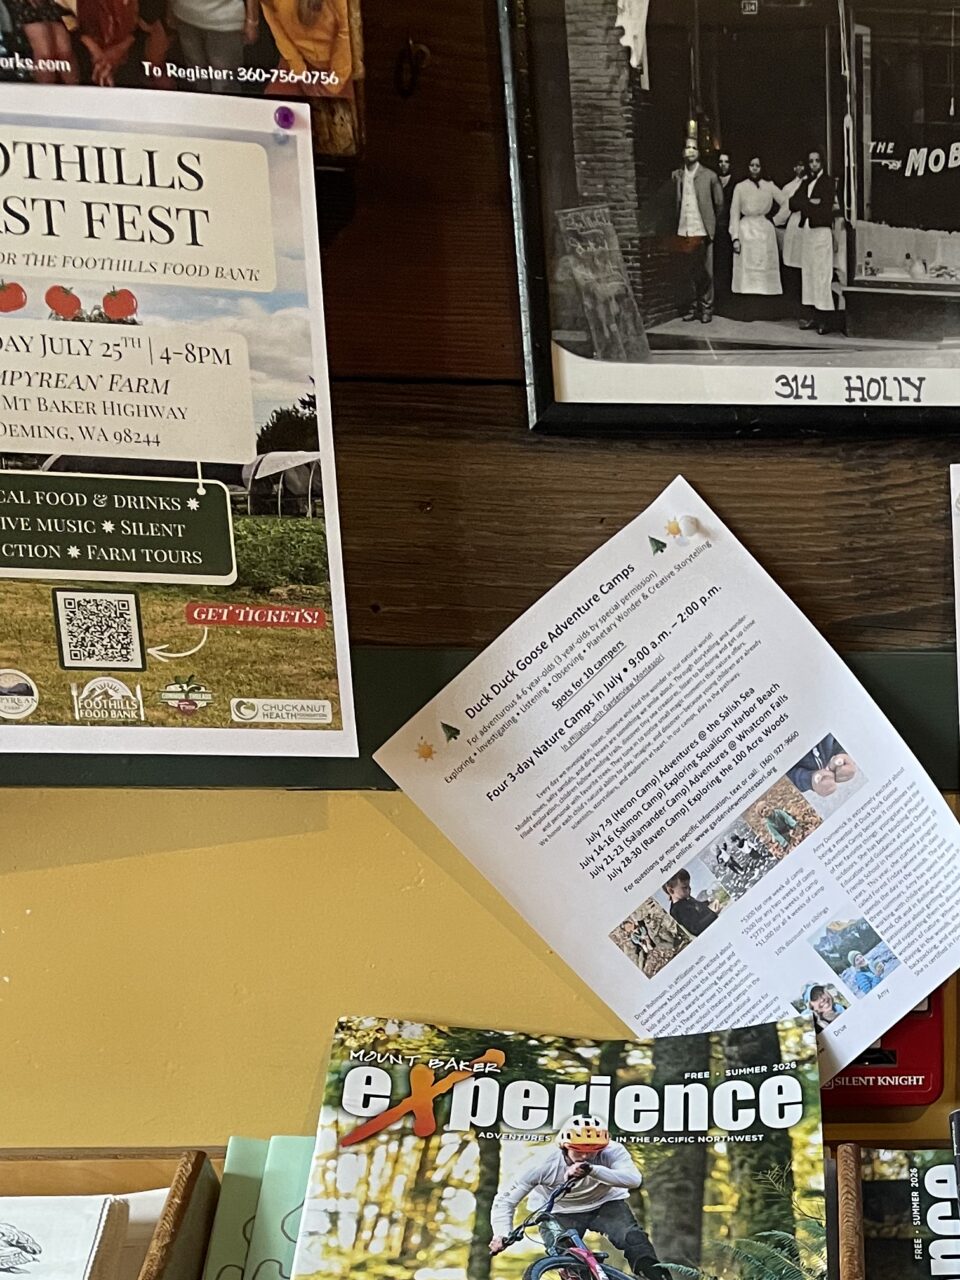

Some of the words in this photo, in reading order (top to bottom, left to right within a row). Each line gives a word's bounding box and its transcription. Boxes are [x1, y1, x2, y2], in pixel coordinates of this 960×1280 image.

[142, 61, 162, 77] To
[166, 63, 234, 82] Register:
[237, 67, 339, 85] 360-756-0756
[868, 141, 895, 154] THE
[83, 200, 209, 247] FEST
[23, 253, 57, 267] THE
[61, 255, 157, 274] FOOTHILLS
[162, 263, 209, 278] FOOD
[214, 265, 260, 282] BANK
[775, 374, 818, 400] 314
[845, 376, 926, 403] HOLLY
[78, 426, 108, 442] WA
[113, 430, 161, 447] 98244
[36, 490, 87, 507] FOOD
[93, 493, 108, 507] &
[113, 494, 181, 511] DRINKS
[37, 518, 96, 534] MUSIC
[141, 548, 203, 564] TOURS
[194, 606, 233, 621] GET
[236, 608, 319, 624] TICKETS!
[465, 692, 493, 720] Duck
[490, 668, 518, 696] Duck
[516, 641, 549, 672] Goose
[548, 593, 601, 643] Adventure
[599, 563, 636, 596] Camps
[78, 699, 138, 710] FOOTHILLS
[262, 704, 325, 713] CHUCKANUT
[80, 709, 108, 719] FOOD
[110, 710, 139, 719] BANK
[262, 712, 297, 720] HEALTH
[486, 782, 509, 802] Four
[507, 756, 536, 784] 3-day
[532, 727, 566, 760] Nature
[564, 700, 596, 730] Camps
[593, 689, 605, 702] in
[604, 671, 624, 695] July
[349, 1049, 417, 1066] MOUNT
[428, 1058, 502, 1073] BAKER
[684, 1071, 709, 1079] FREE
[725, 1066, 768, 1076] SUMMER
[772, 1061, 797, 1071] 2026
[835, 1076, 875, 1086] SILENT
[877, 1075, 925, 1087] KNIGHT
[478, 1131, 551, 1142] ADVENTURES
[652, 1135, 695, 1143] PACIFIC
[698, 1134, 764, 1143] NORTHWEST
